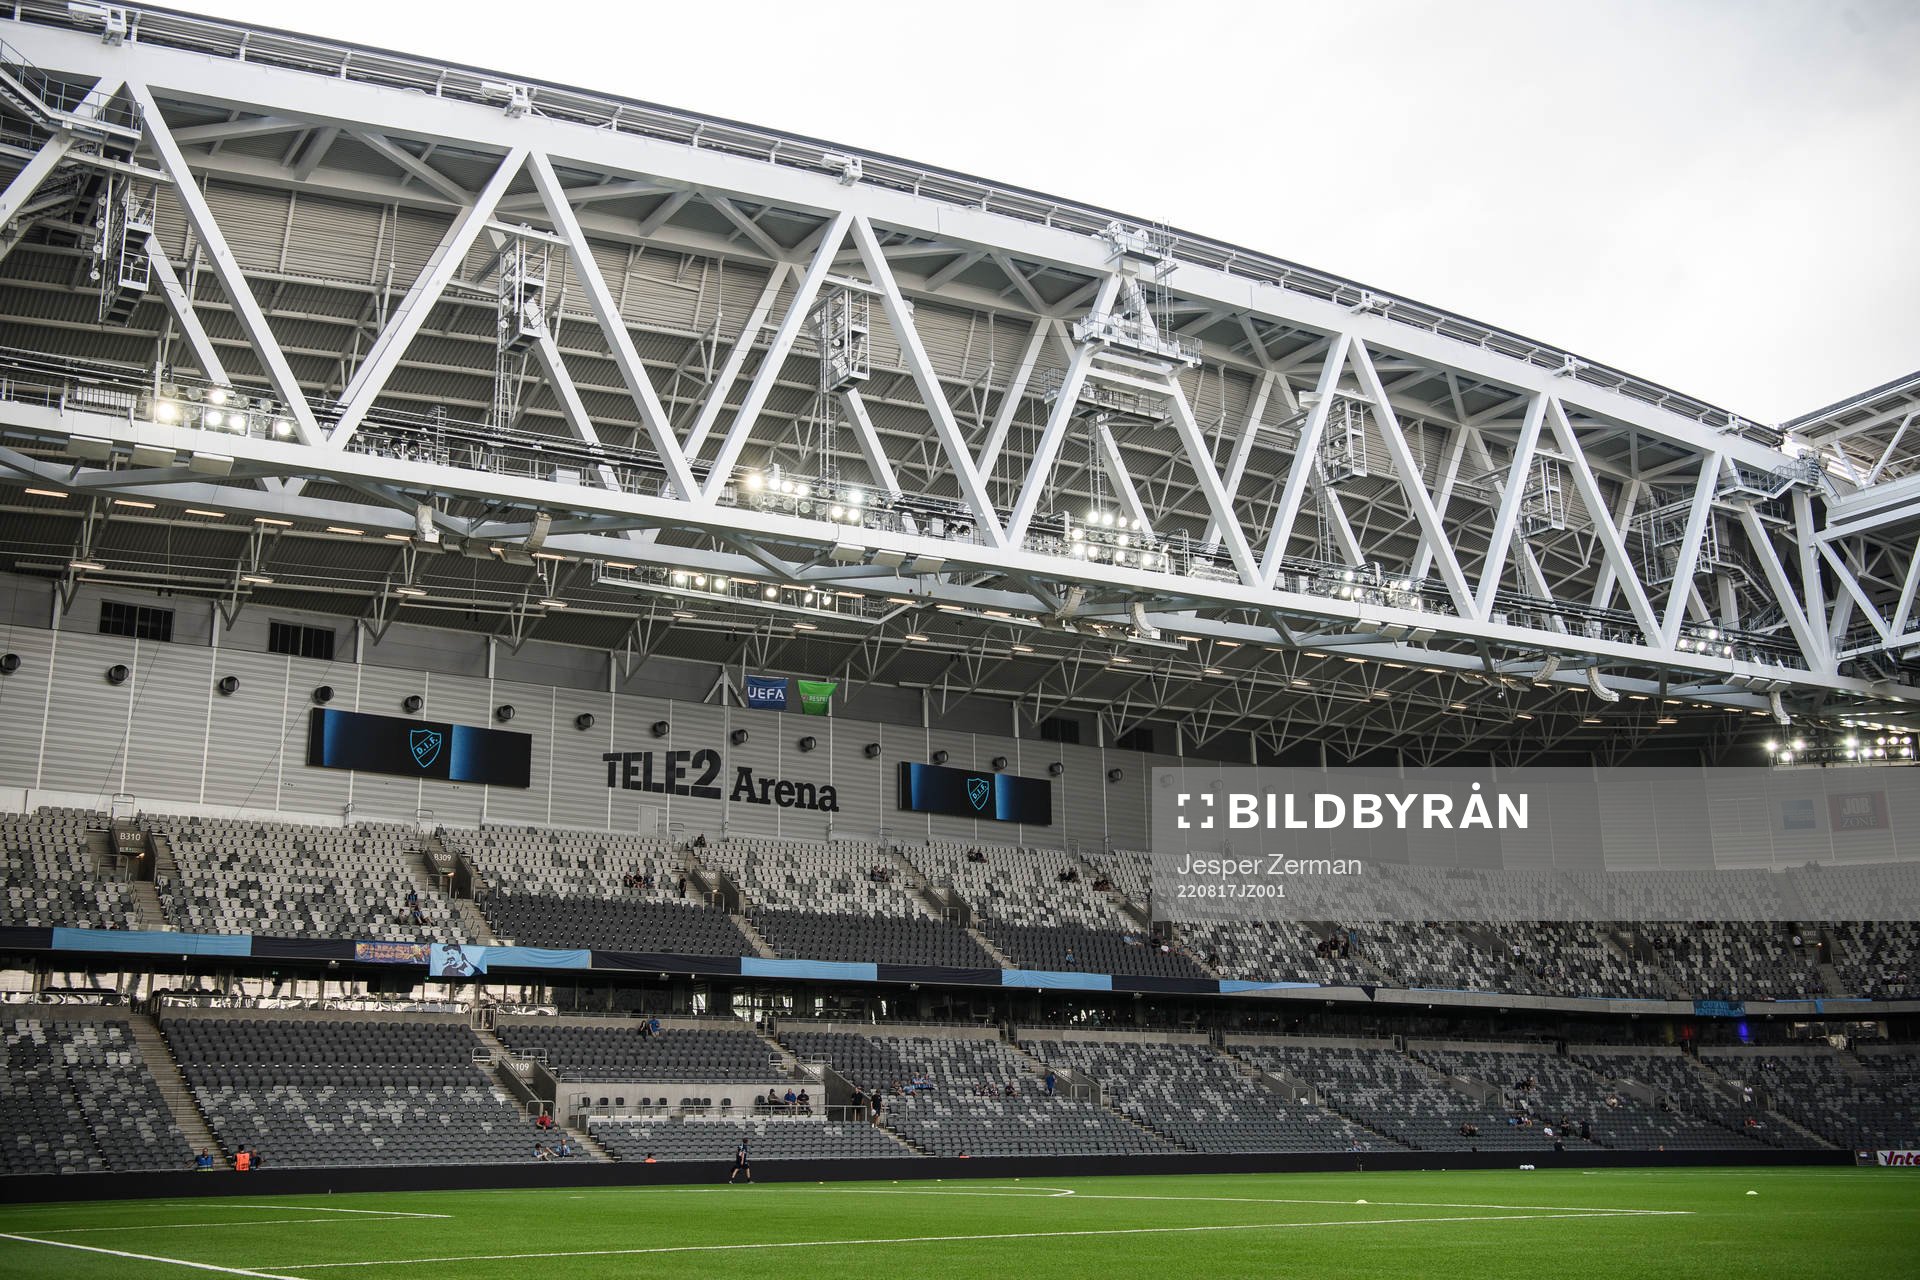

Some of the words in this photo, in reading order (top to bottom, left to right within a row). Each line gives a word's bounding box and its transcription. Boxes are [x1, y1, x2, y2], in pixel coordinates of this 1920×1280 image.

[747, 686, 785, 700] UEFA
[602, 749, 722, 800] TELE2
[730, 766, 839, 813] Arena
[1843, 798, 1871, 814] JOB
[1842, 815, 1879, 828] ZONE
[120, 832, 141, 841] B310
